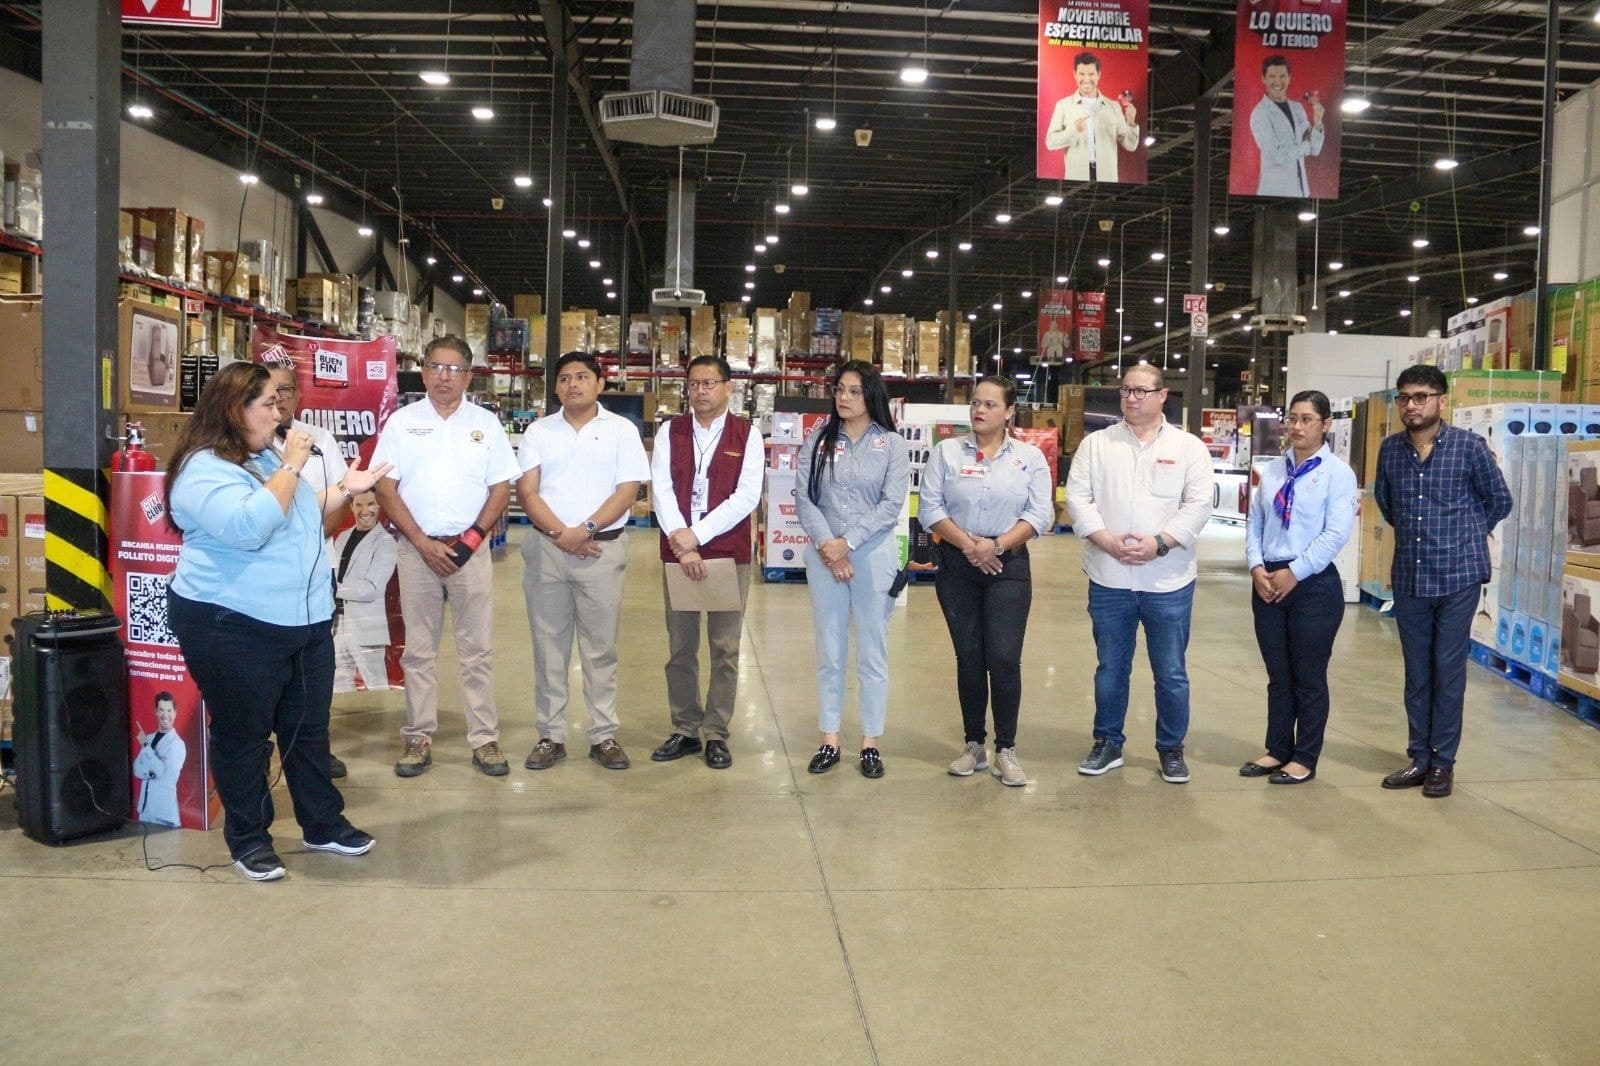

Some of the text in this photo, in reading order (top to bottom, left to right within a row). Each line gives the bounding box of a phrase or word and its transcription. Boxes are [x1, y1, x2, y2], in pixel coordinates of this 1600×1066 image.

[1058, 7, 1131, 26] NOVIEMBRE
[1249, 11, 1332, 33] LO QUIERO
[1044, 22, 1143, 43] ESPECTACULAR
[1262, 32, 1319, 48] LO TENGO
[319, 354, 343, 366] BUEN
[300, 408, 376, 436] QUIERO
[146, 503, 163, 520] CLUB
[118, 550, 180, 563] FOLLETO DIGIT
[156, 652, 177, 661] todas
[129, 668, 159, 679] tenemos
[172, 665, 186, 673] que
